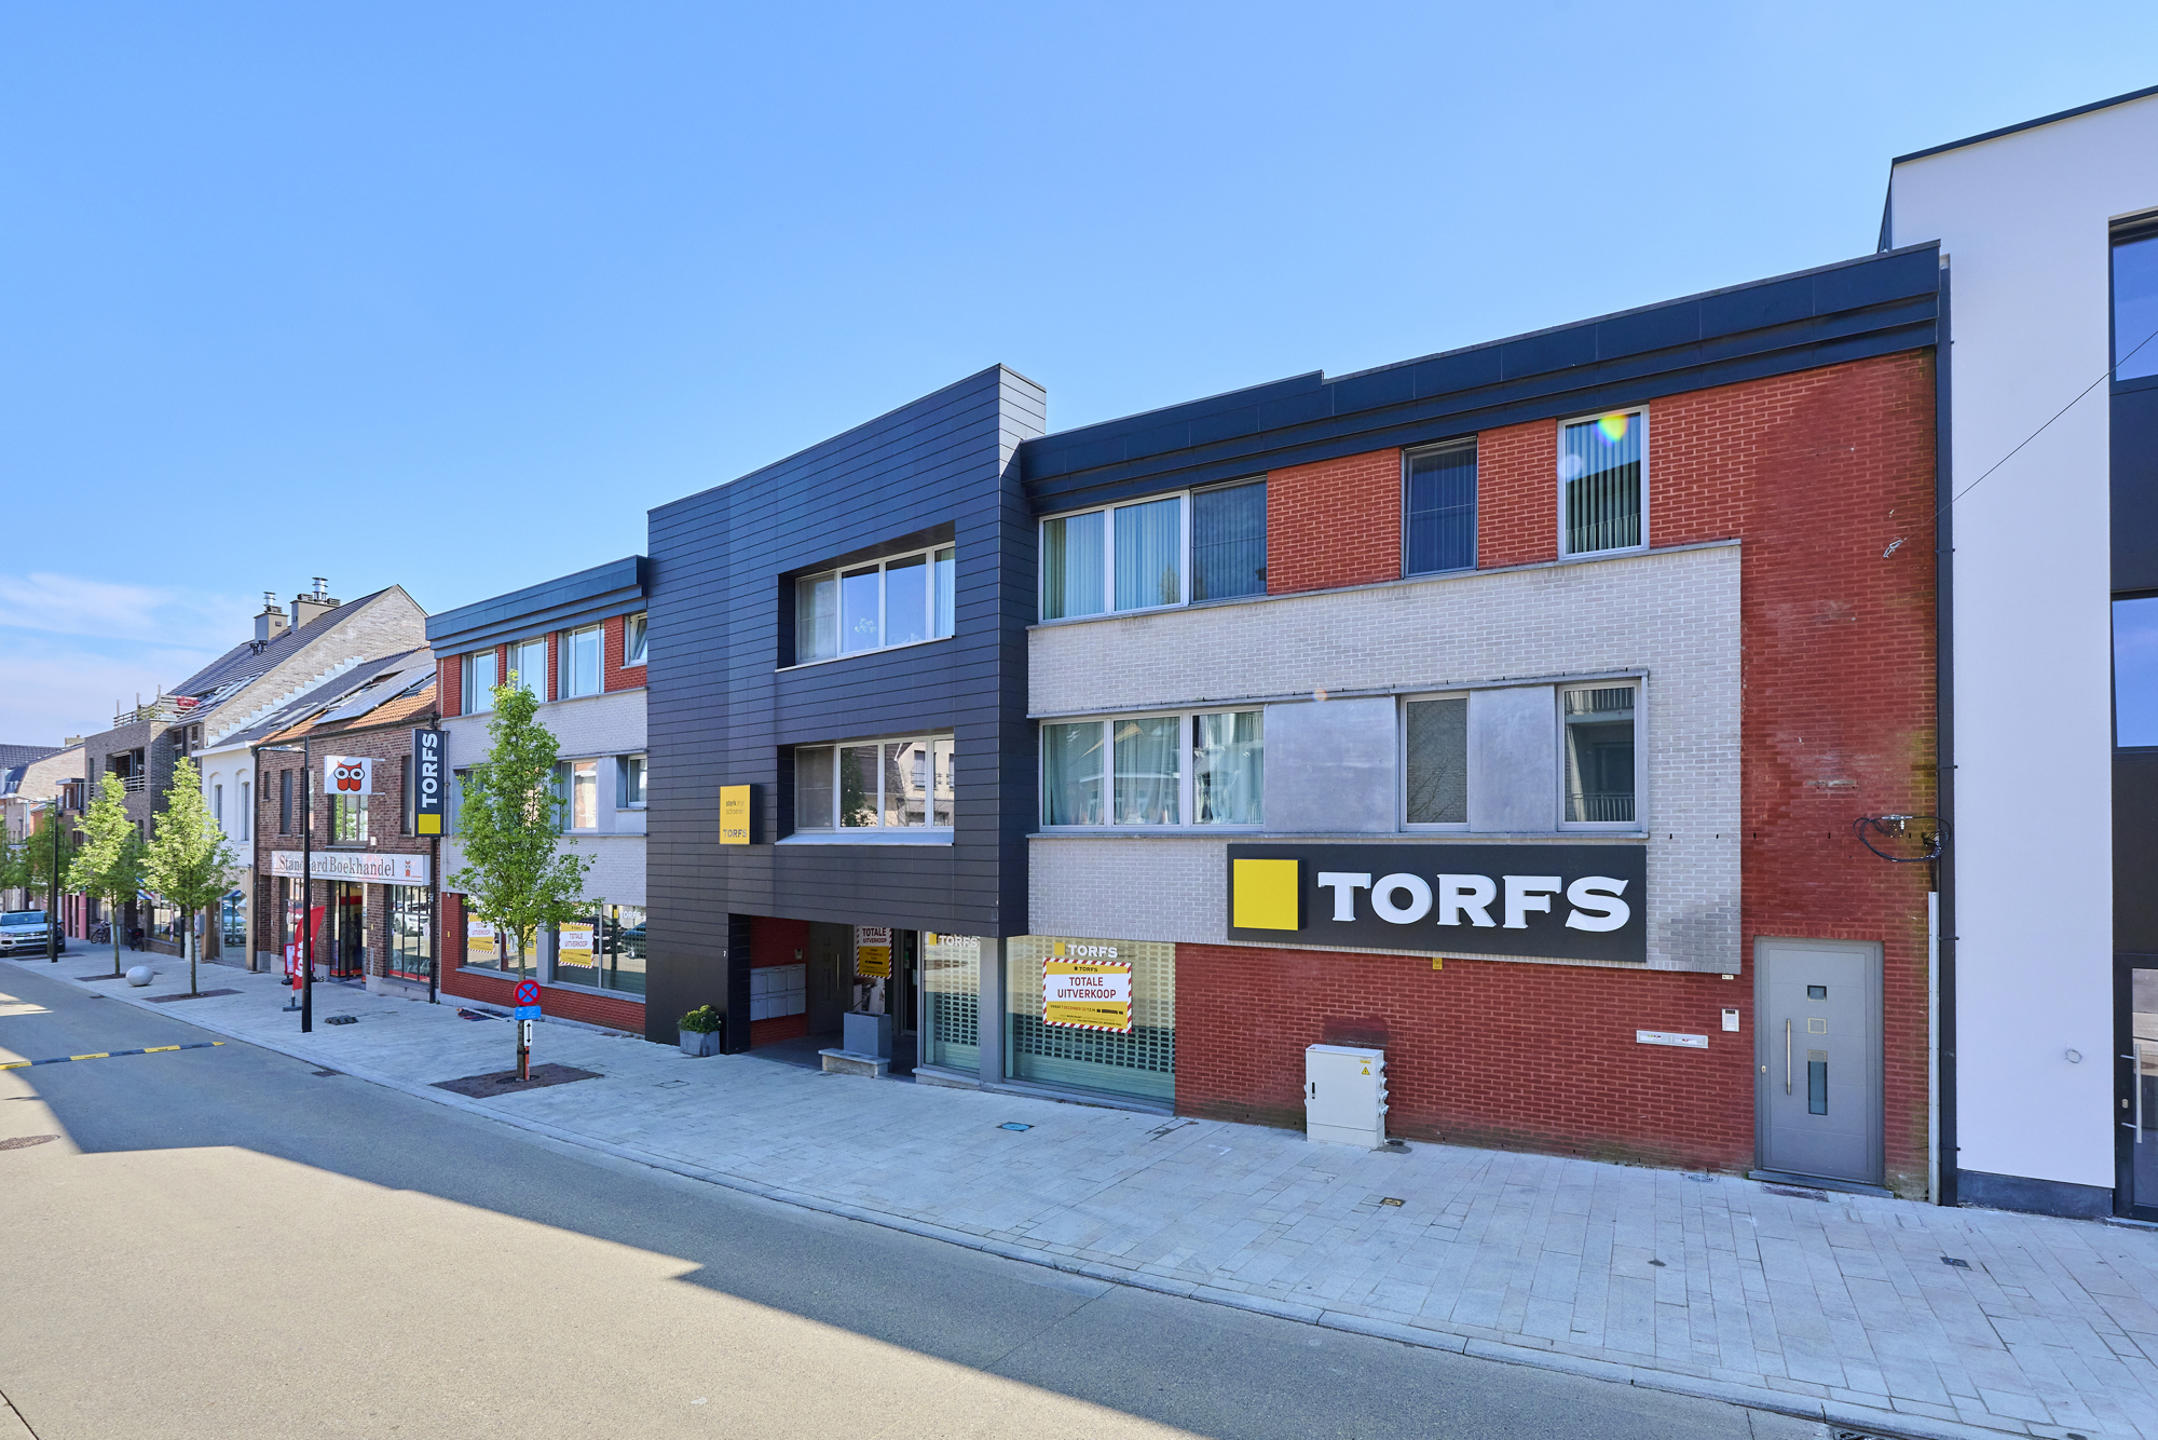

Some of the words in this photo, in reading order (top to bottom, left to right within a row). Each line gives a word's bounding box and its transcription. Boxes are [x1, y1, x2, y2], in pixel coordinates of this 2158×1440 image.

[422, 733, 438, 808] TORFS
[723, 829, 748, 838] TORFS
[279, 855, 328, 874] Standard
[329, 856, 395, 877] Boekhandel
[1317, 871, 1631, 933] TORFS
[862, 928, 887, 936] TOTALE
[938, 935, 979, 948] TORFS
[1068, 944, 1118, 958] TORFS
[1069, 977, 1104, 987] TOTALE
[1057, 989, 1117, 999] UITVERKOOP
